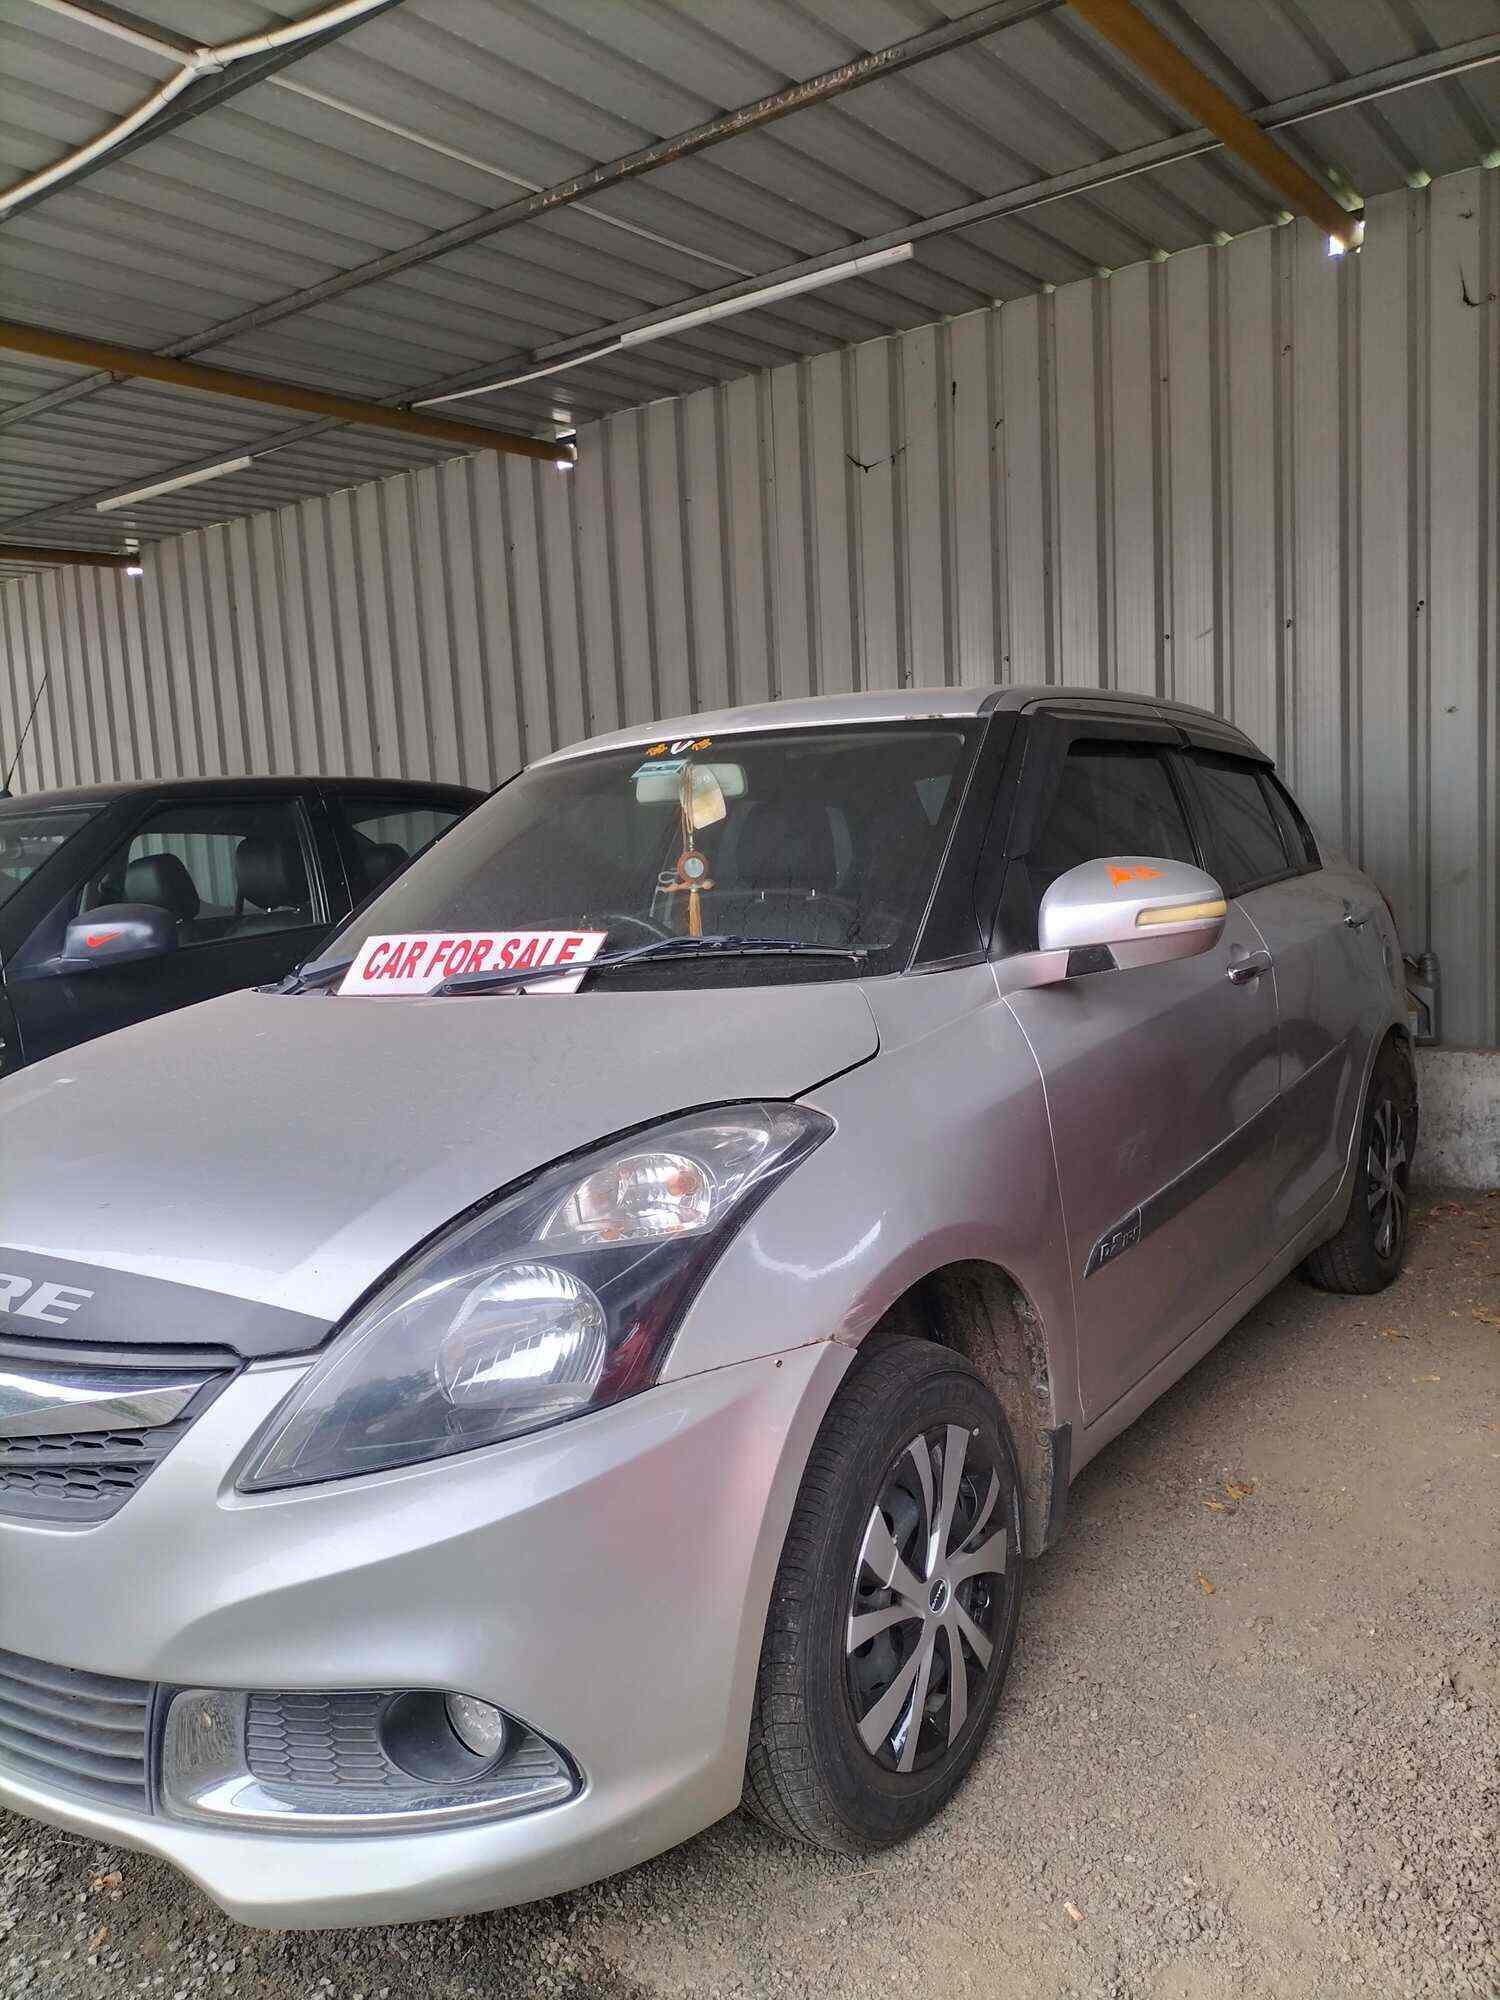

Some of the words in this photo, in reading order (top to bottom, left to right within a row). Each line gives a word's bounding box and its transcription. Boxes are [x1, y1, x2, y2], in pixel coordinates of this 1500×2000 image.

[362, 941, 429, 981] CAR
[422, 939, 494, 978] FOR
[493, 938, 584, 971] SALE
